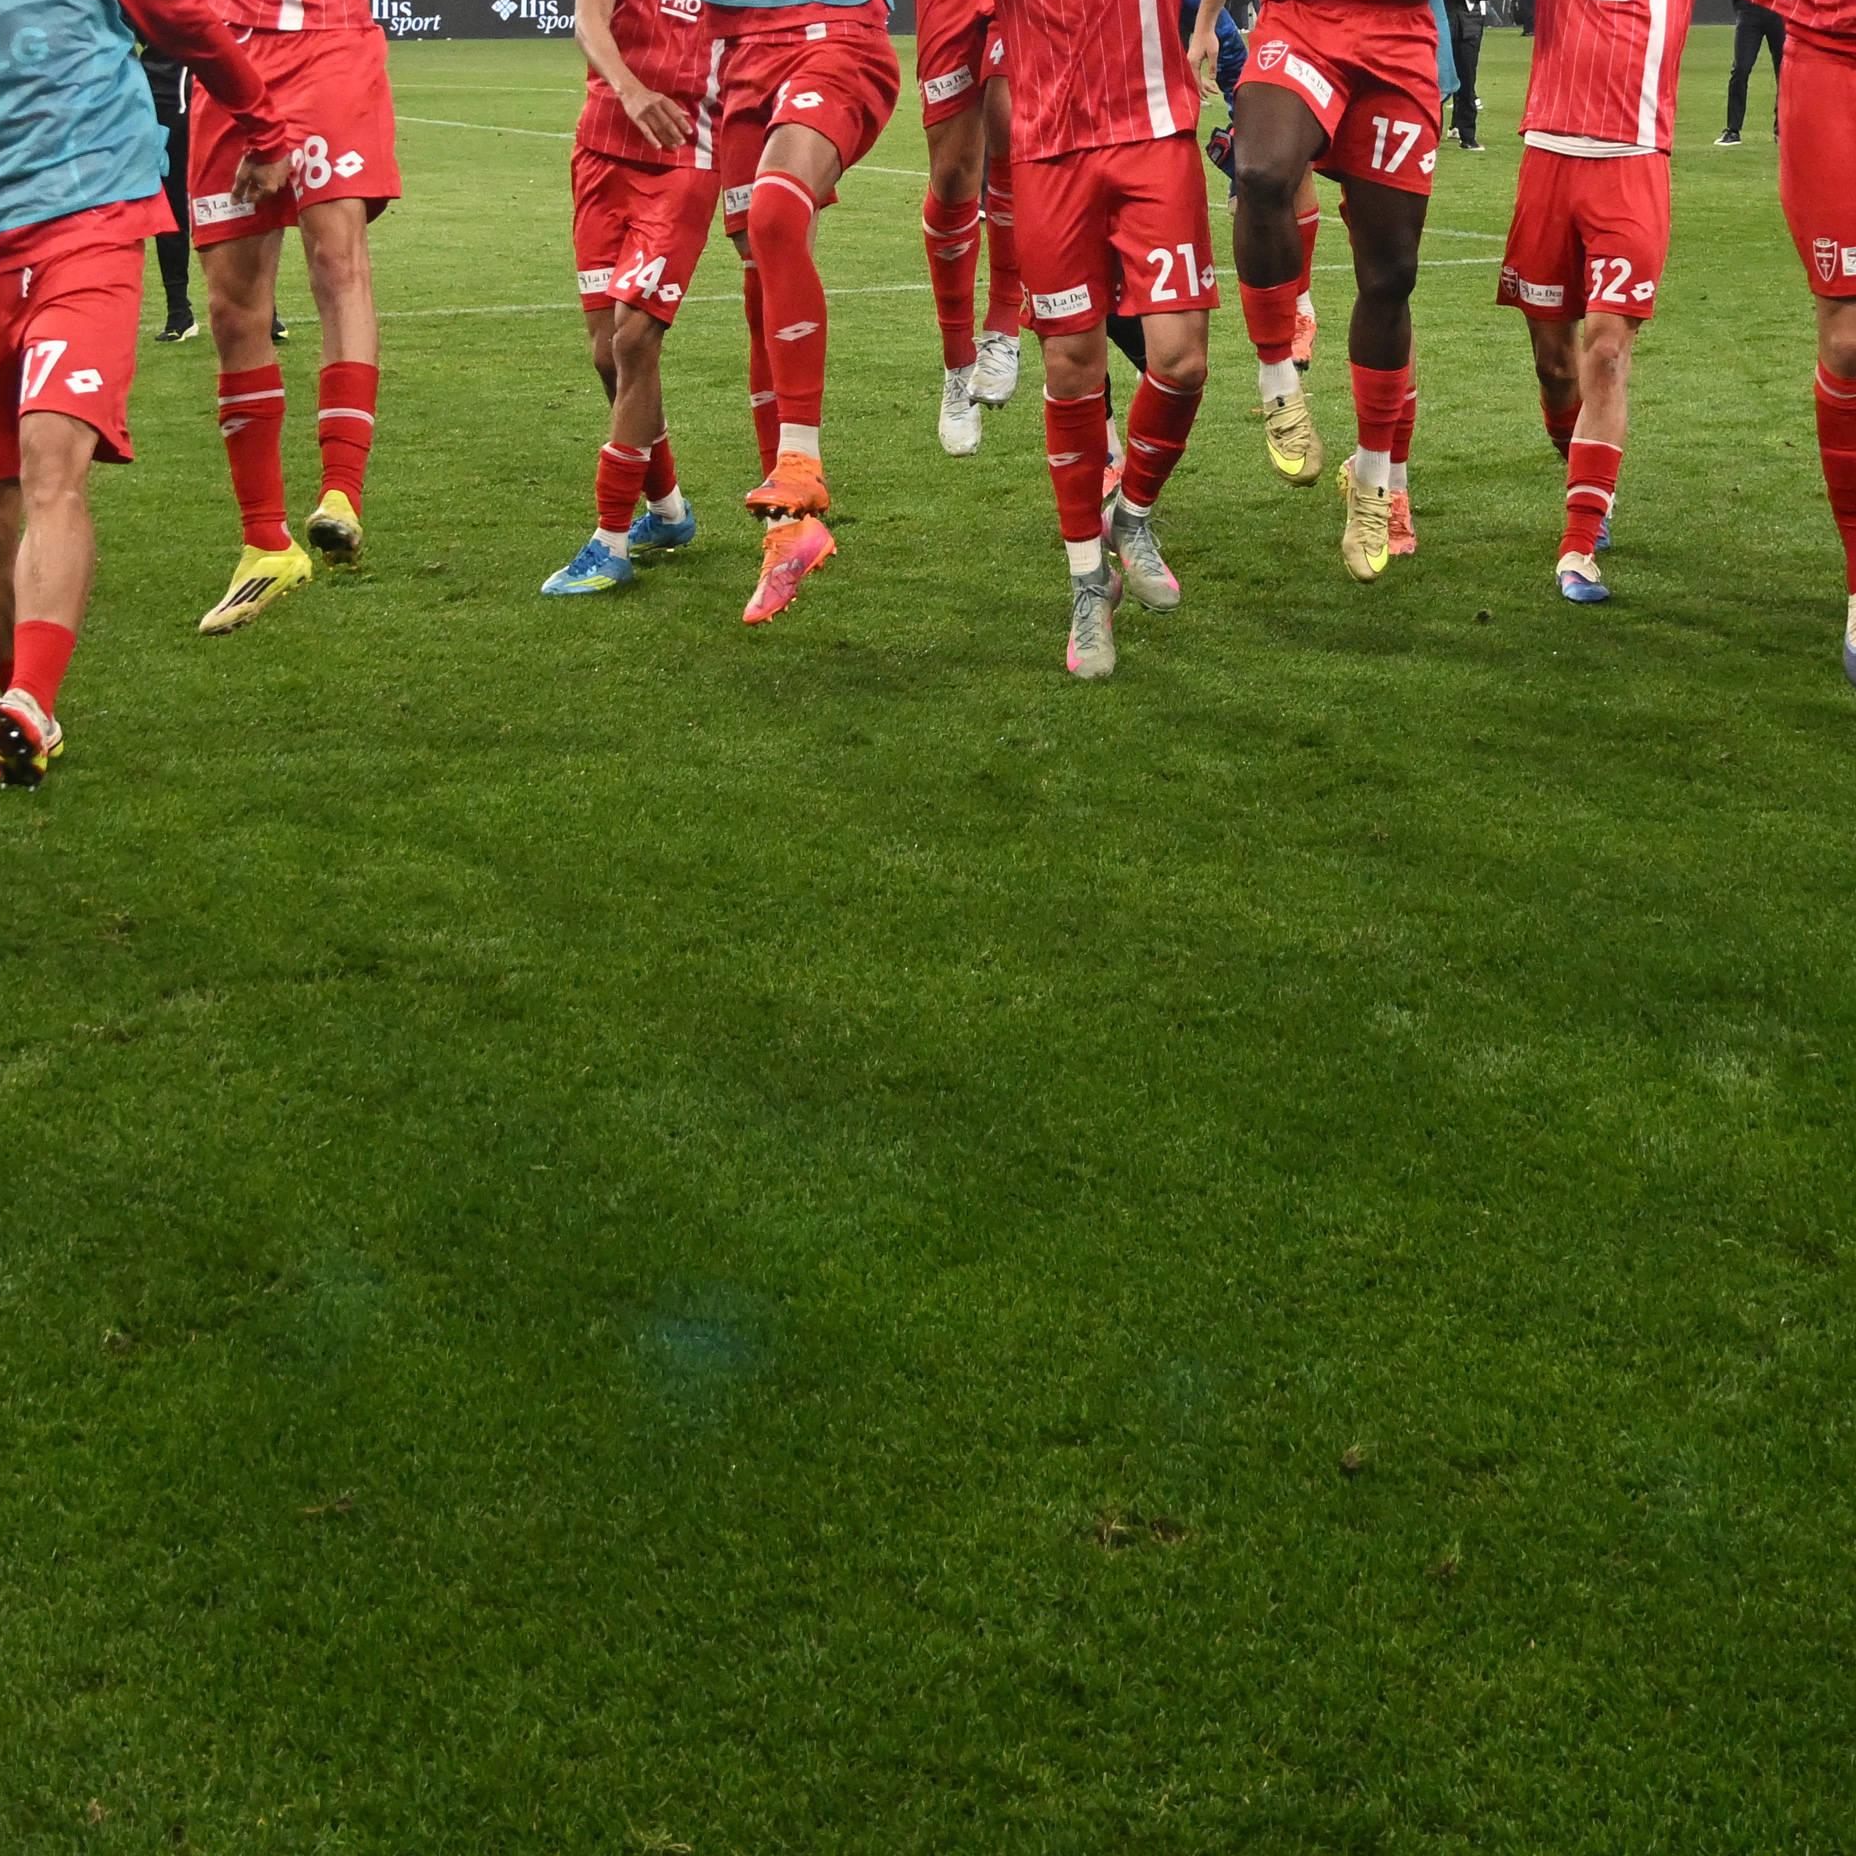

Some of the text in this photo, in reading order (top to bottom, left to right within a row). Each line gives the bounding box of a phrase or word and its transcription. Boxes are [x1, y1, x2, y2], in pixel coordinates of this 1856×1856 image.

[389, 10, 440, 38] sport
[1371, 116, 1422, 173] 17
[616, 248, 667, 299] 24
[1147, 243, 1198, 301] 21
[1588, 257, 1632, 304] 32
[1053, 291, 1088, 307] La Dea
